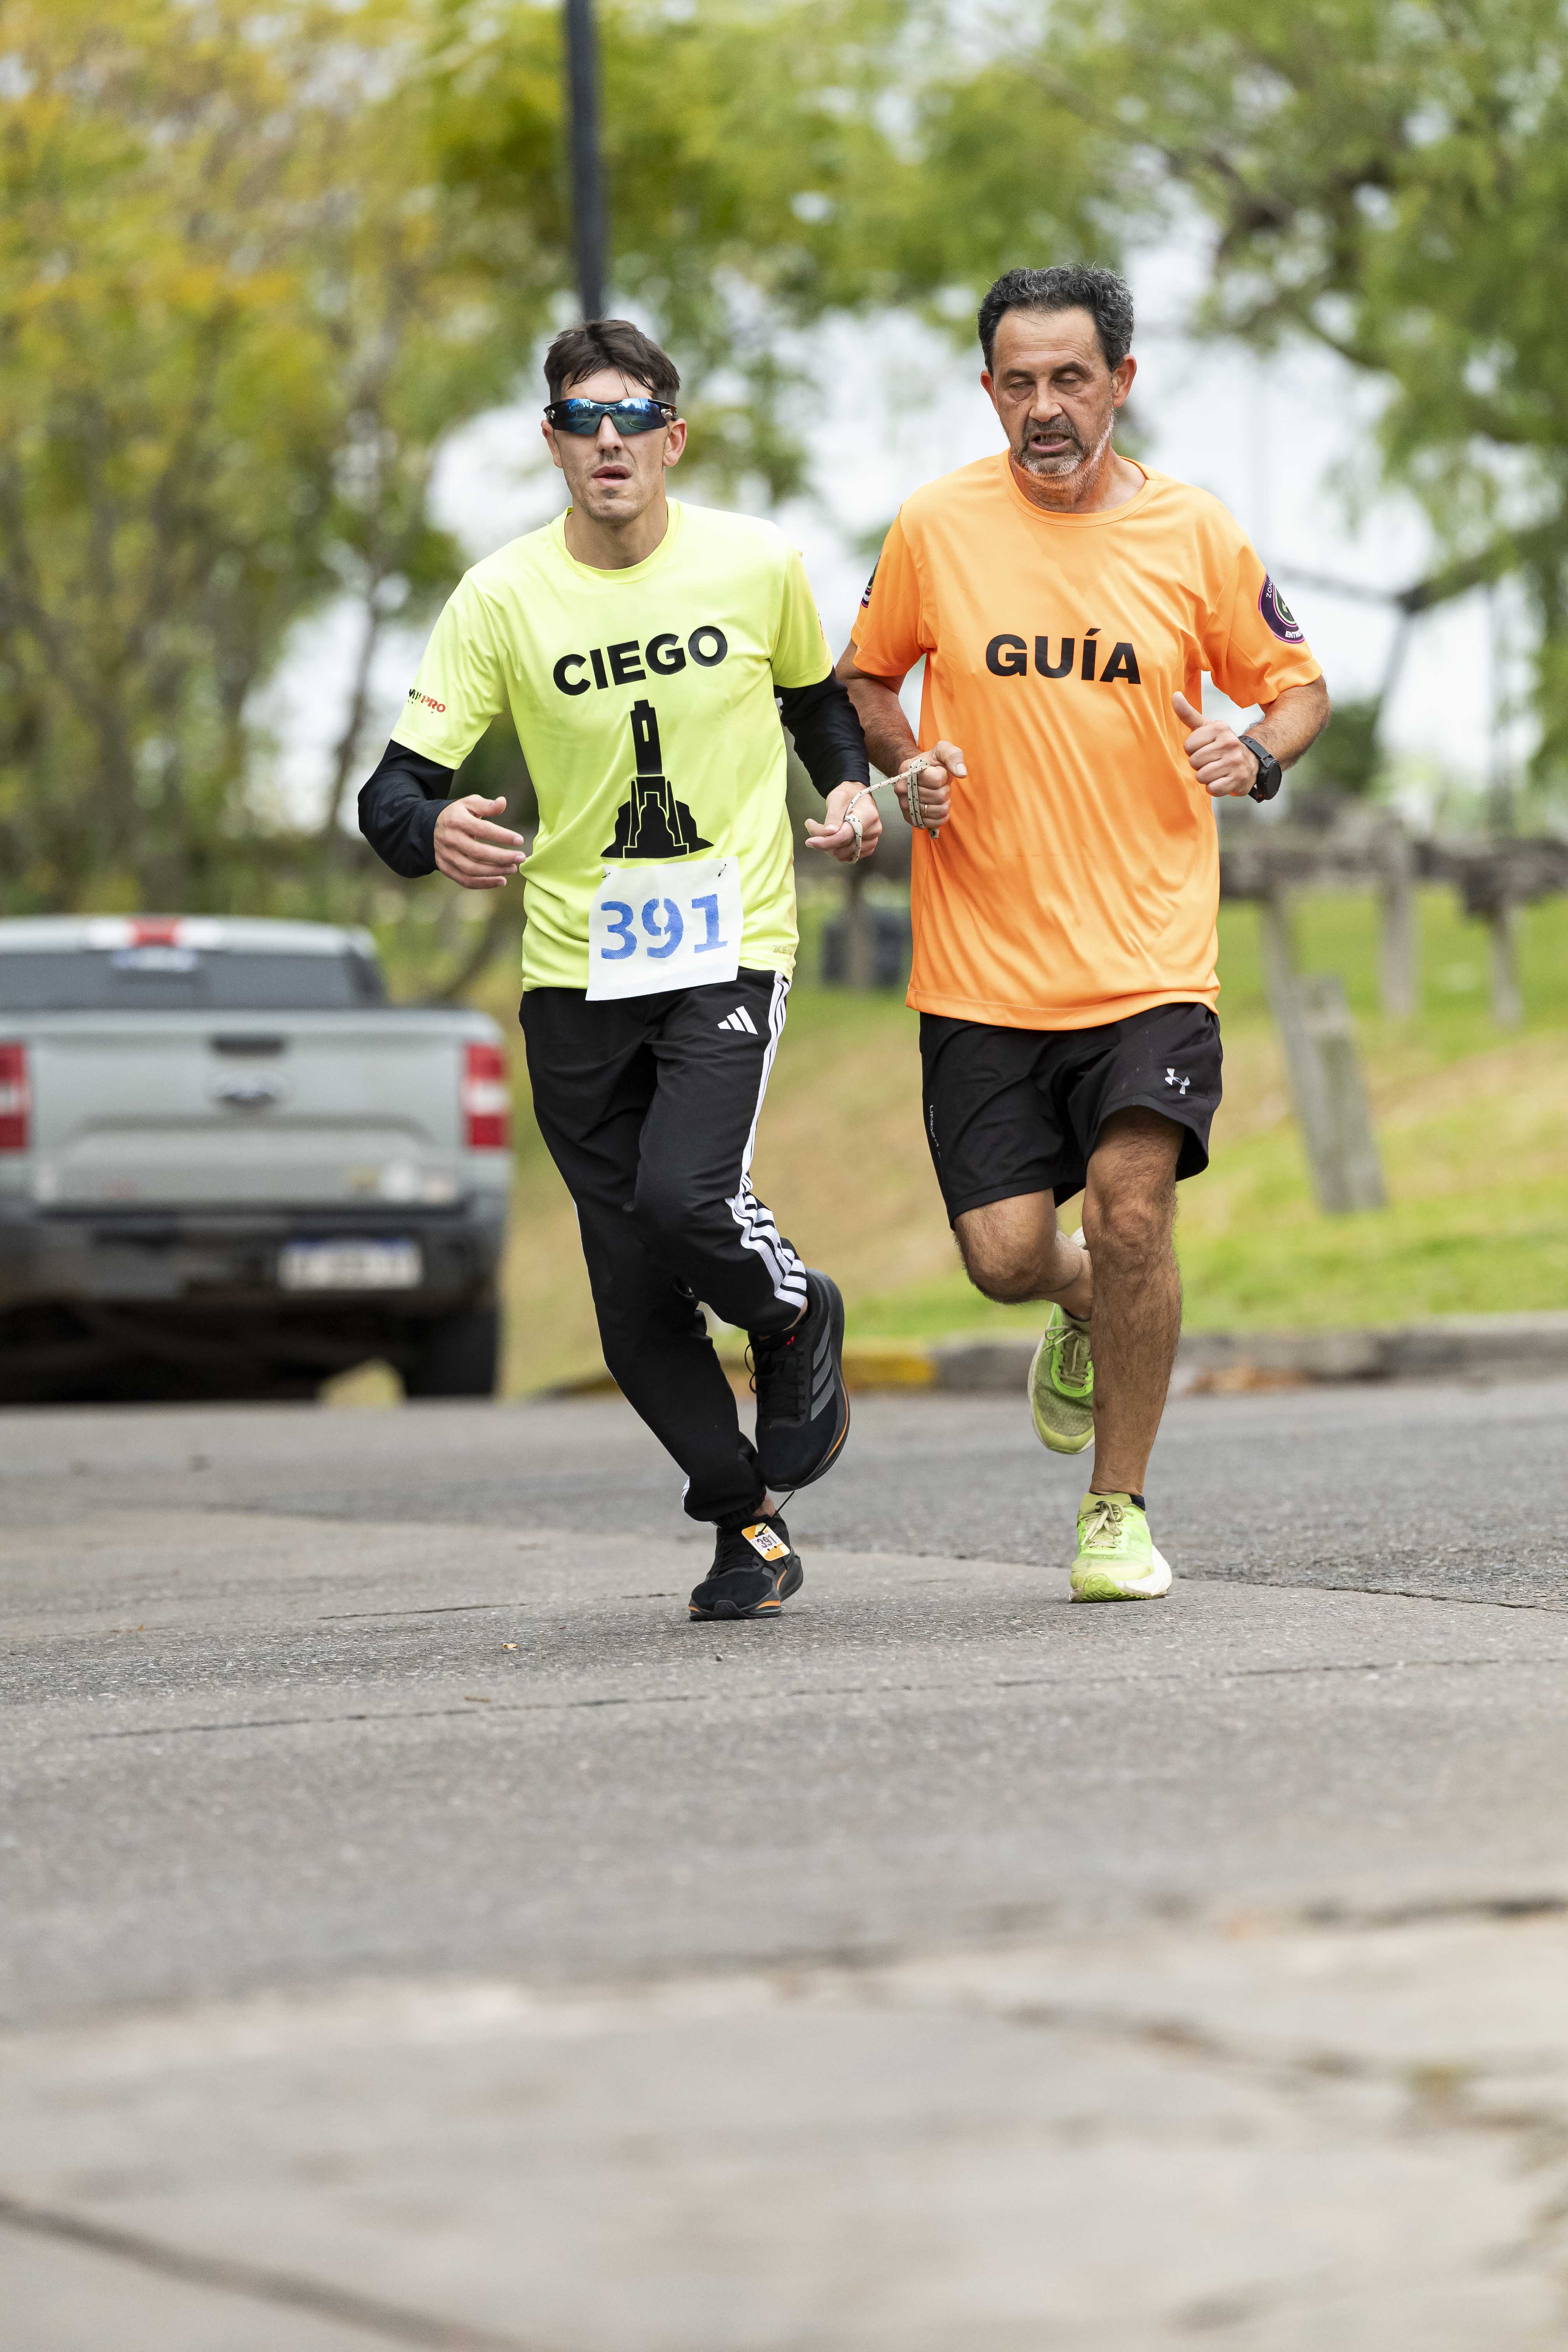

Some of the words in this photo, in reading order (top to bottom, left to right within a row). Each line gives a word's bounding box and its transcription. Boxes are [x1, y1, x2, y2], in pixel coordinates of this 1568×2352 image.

[553, 625, 728, 696] CIEGO
[985, 628, 1141, 685] GUÍA
[600, 894, 728, 960] 391
[757, 1534, 777, 1548] 391
